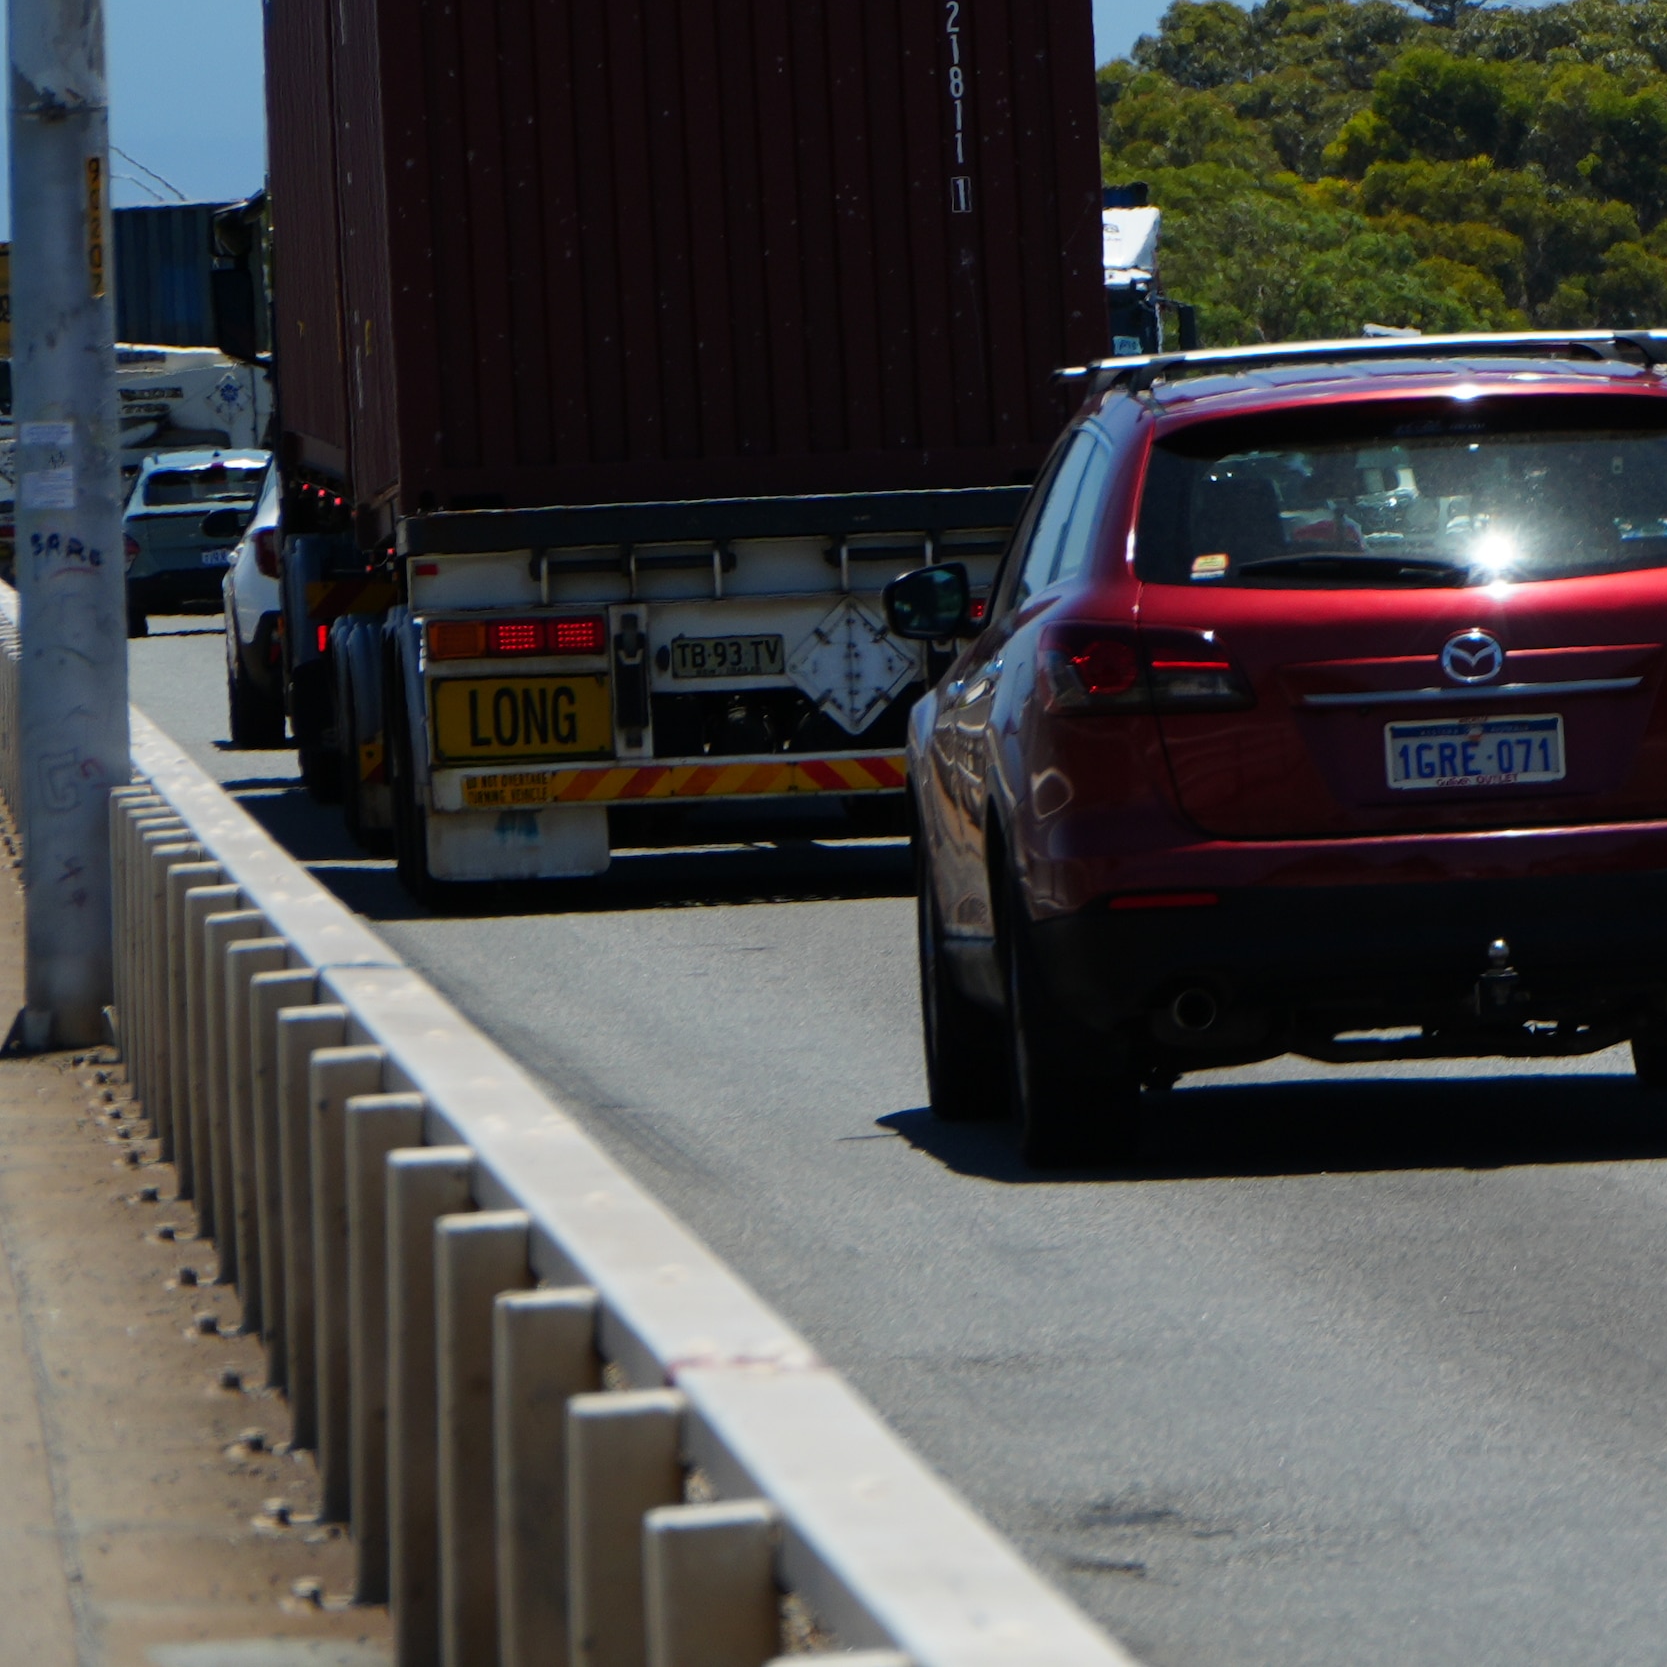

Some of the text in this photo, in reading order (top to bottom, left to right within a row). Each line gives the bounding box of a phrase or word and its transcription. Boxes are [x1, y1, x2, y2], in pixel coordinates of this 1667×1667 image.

[953, 177, 969, 212] 1
[468, 685, 578, 747] LONG
[1476, 773, 1519, 784] OUTLET
